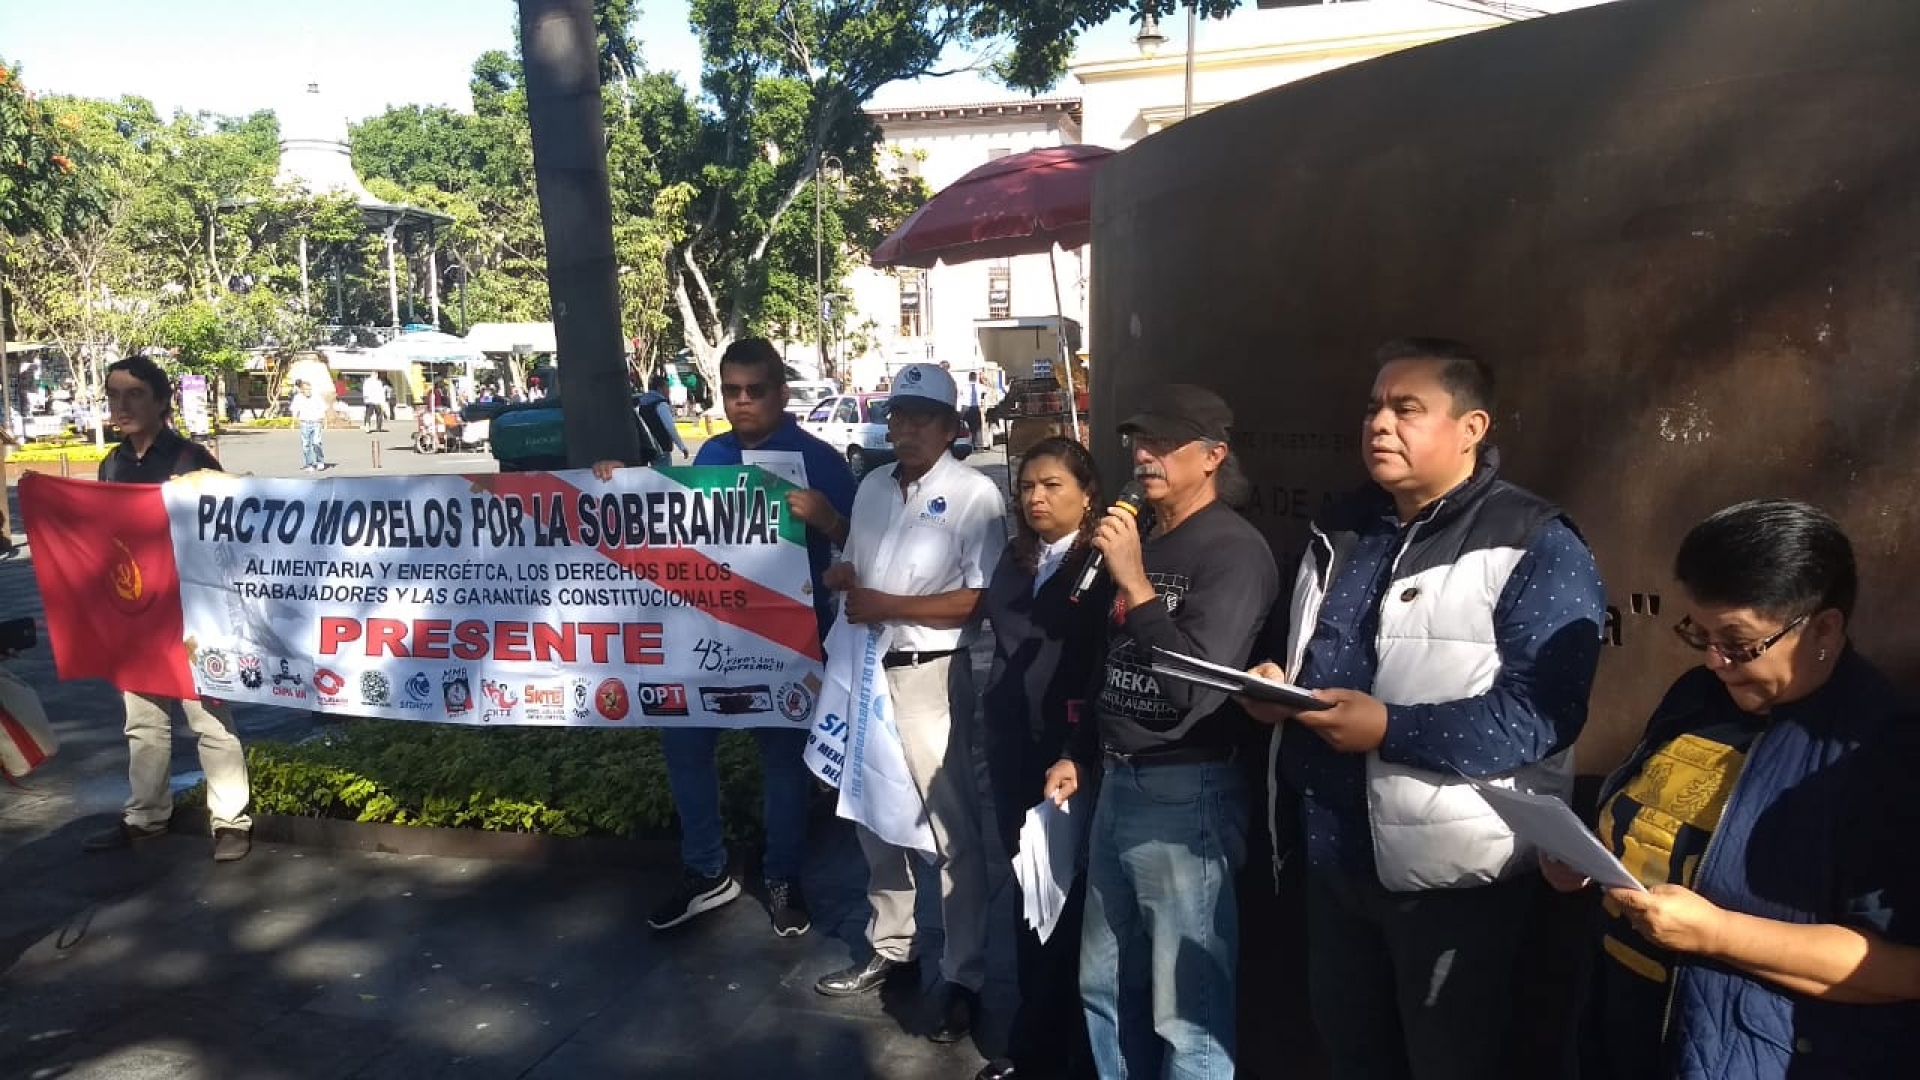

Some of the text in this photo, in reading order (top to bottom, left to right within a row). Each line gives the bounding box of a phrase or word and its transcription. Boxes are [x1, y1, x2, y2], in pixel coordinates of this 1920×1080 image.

[198, 474, 780, 548] PACTO MORELOS POR LA SOBERANÍA:
[245, 559, 732, 582] ALIMENTARIA Y ENERGÉTCA, LOS DERECHOS DE LOS
[234, 582, 748, 608] TRABAJADORES Y LAS GARANTÍAS CONSTITUCIONALES
[319, 617, 665, 664] PRESENTE
[641, 686, 683, 704] OPT
